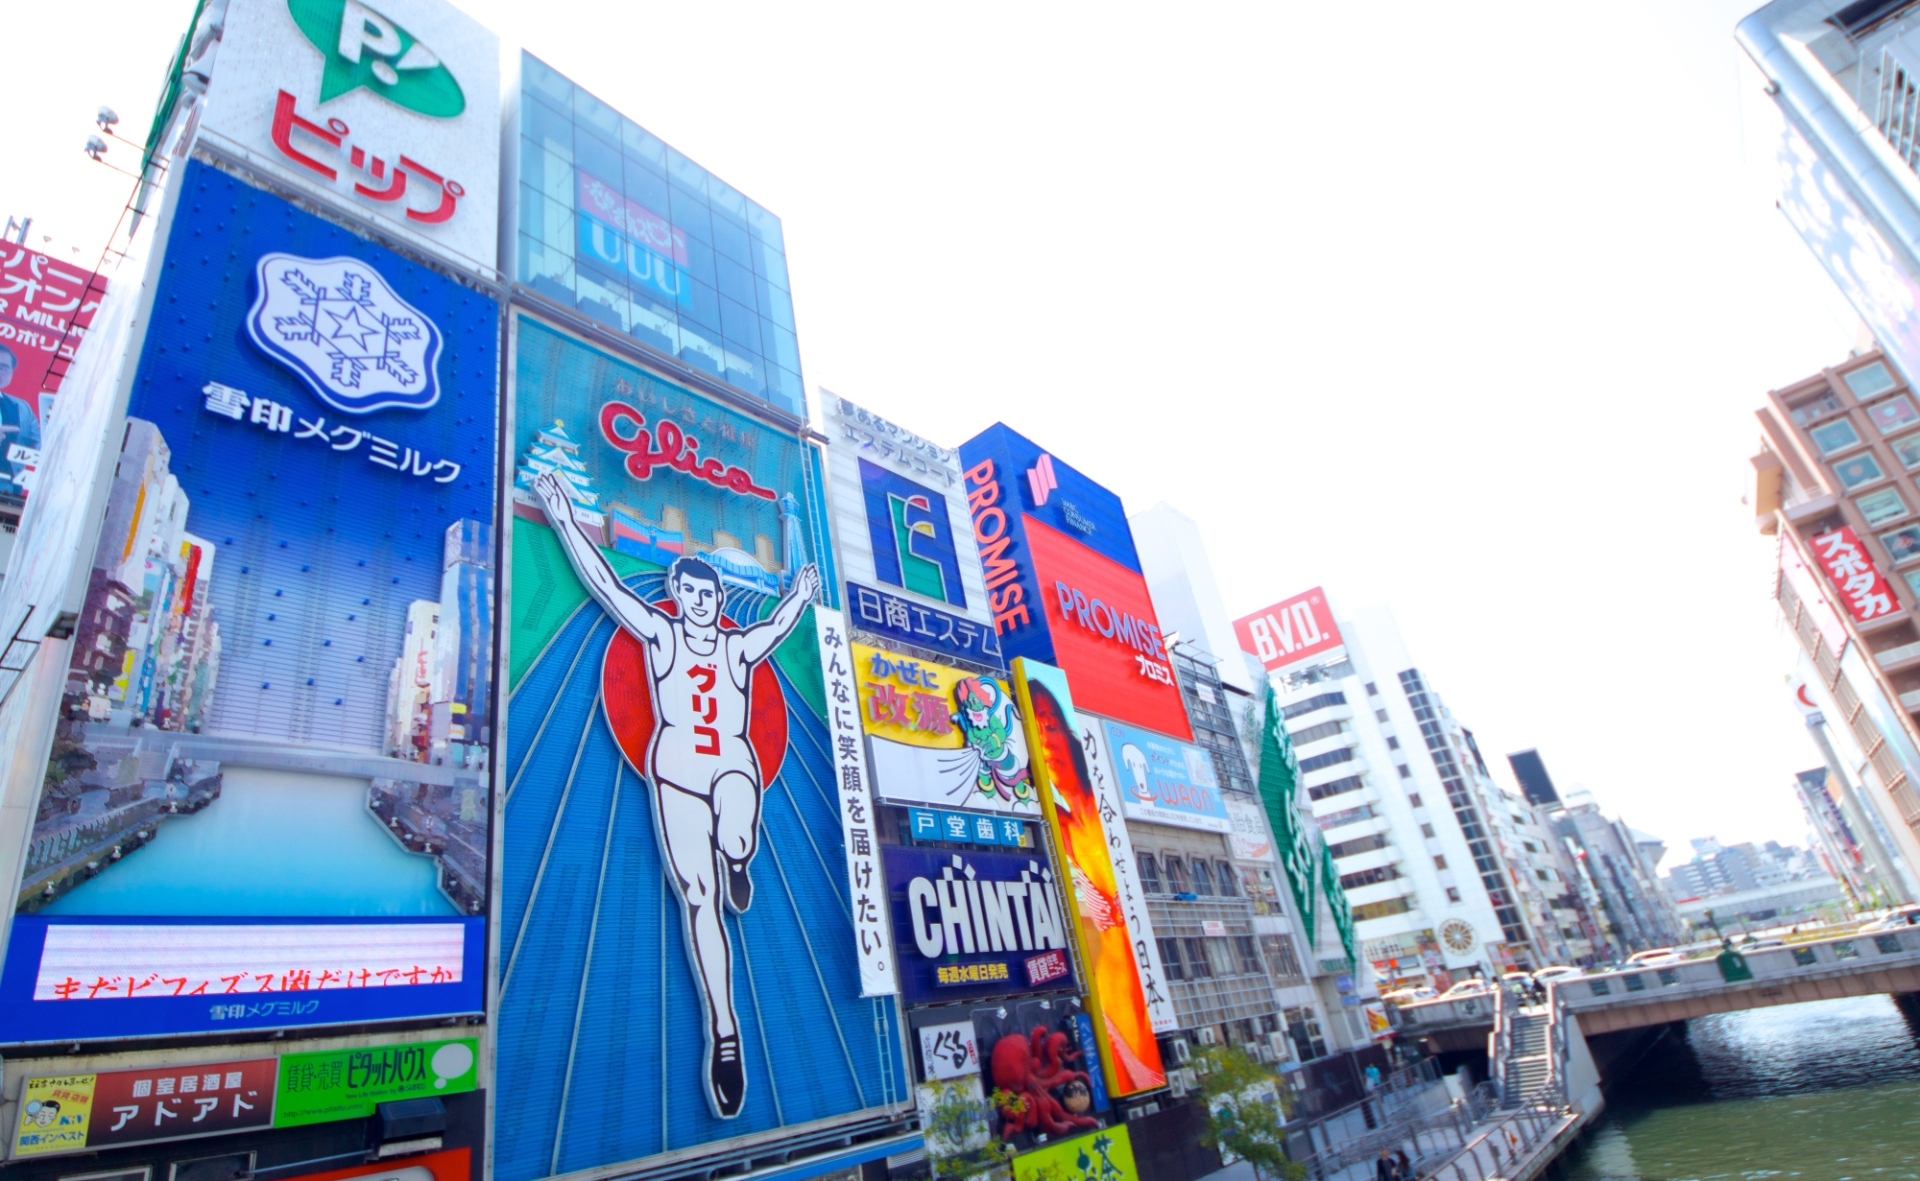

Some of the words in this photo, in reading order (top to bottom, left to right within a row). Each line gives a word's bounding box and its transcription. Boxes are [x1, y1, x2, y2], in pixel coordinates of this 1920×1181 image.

[270, 88, 466, 225] ピップ
[203, 381, 462, 484] 雪印メグミルク
[599, 401, 778, 501] Glico
[843, 422, 956, 488] エステムコート
[962, 457, 1030, 637] PROMISE
[1816, 532, 1892, 619] スポタカ
[858, 587, 1002, 656] 日商エステム
[1056, 580, 1167, 662] PROMISE
[1248, 600, 1330, 664] B.V.D.
[870, 652, 940, 690] かぜに
[1135, 654, 1174, 687] プロミス
[686, 663, 721, 757] グリコ
[865, 681, 954, 736] 改源
[824, 626, 885, 972] みんなに笑顔を届けたい。
[916, 811, 1021, 842] 戸堂歯科
[1083, 728, 1165, 1016] 力を合わせよう日本
[908, 855, 1066, 958] CHINTAI
[937, 962, 1009, 984] 毎週水曜日発売
[209, 1000, 320, 1020] 雪印メグミルク
[132, 1071, 243, 1098] 個室居酒屋
[346, 1046, 427, 1089] ピタットハウス
[110, 1090, 258, 1132] アドアド
